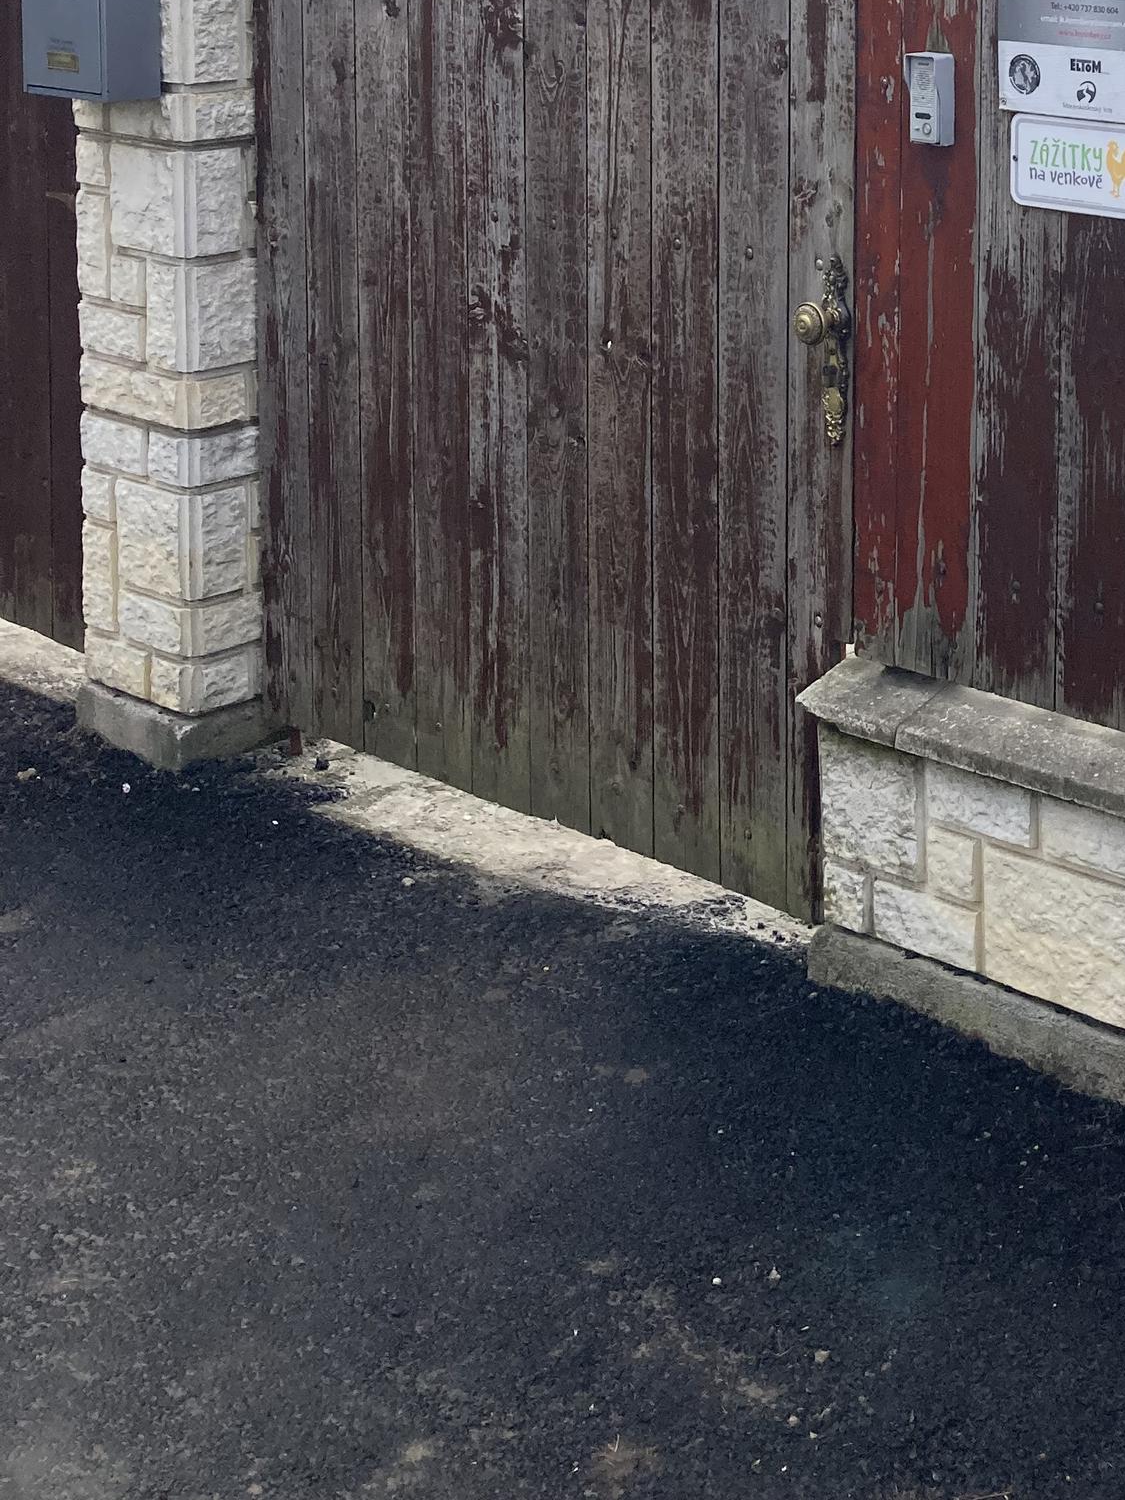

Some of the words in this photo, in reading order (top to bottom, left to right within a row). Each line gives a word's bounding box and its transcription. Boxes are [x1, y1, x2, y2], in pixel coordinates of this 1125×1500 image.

[1064, 3, 1079, 12] +420
[1080, 4, 1092, 13] 737
[1106, 6, 1119, 14] 604
[1029, 167, 1046, 182] na
[1050, 170, 1103, 190] venkově
